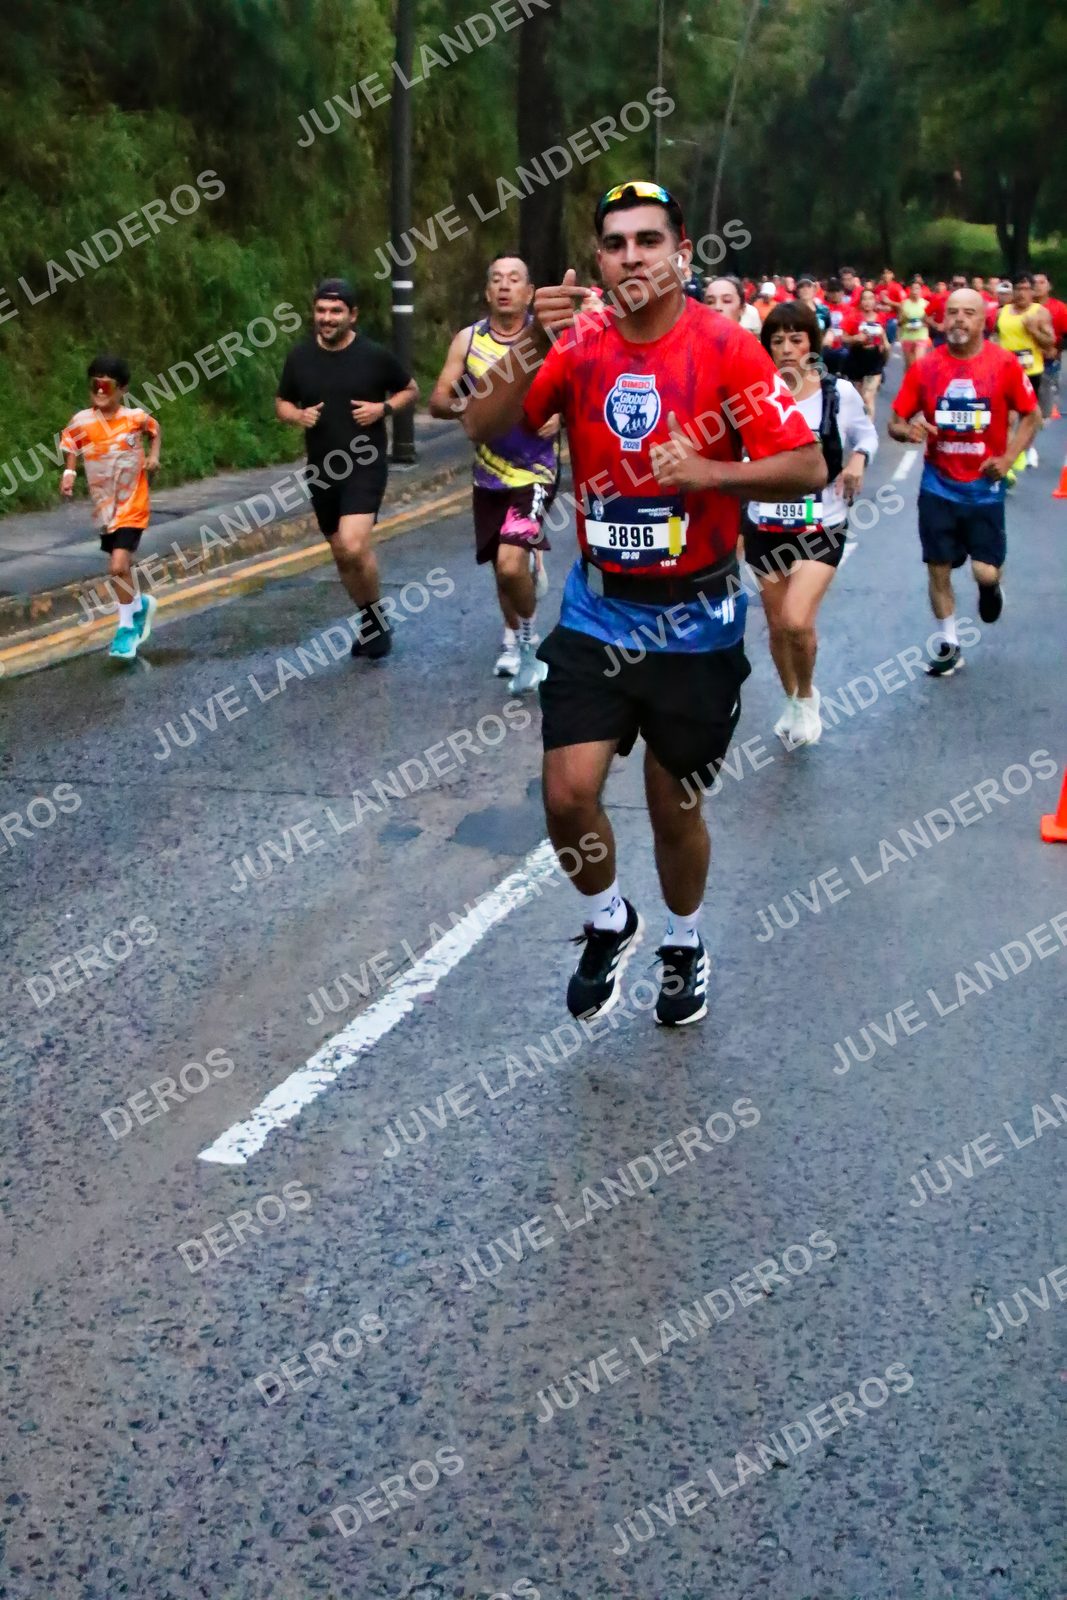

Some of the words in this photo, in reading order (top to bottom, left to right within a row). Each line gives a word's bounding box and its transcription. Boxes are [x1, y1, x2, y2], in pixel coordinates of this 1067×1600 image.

[621, 392, 649, 405] Global
[613, 402, 637, 415] Race
[776, 504, 803, 517] 4994
[608, 525, 654, 548] 3896
